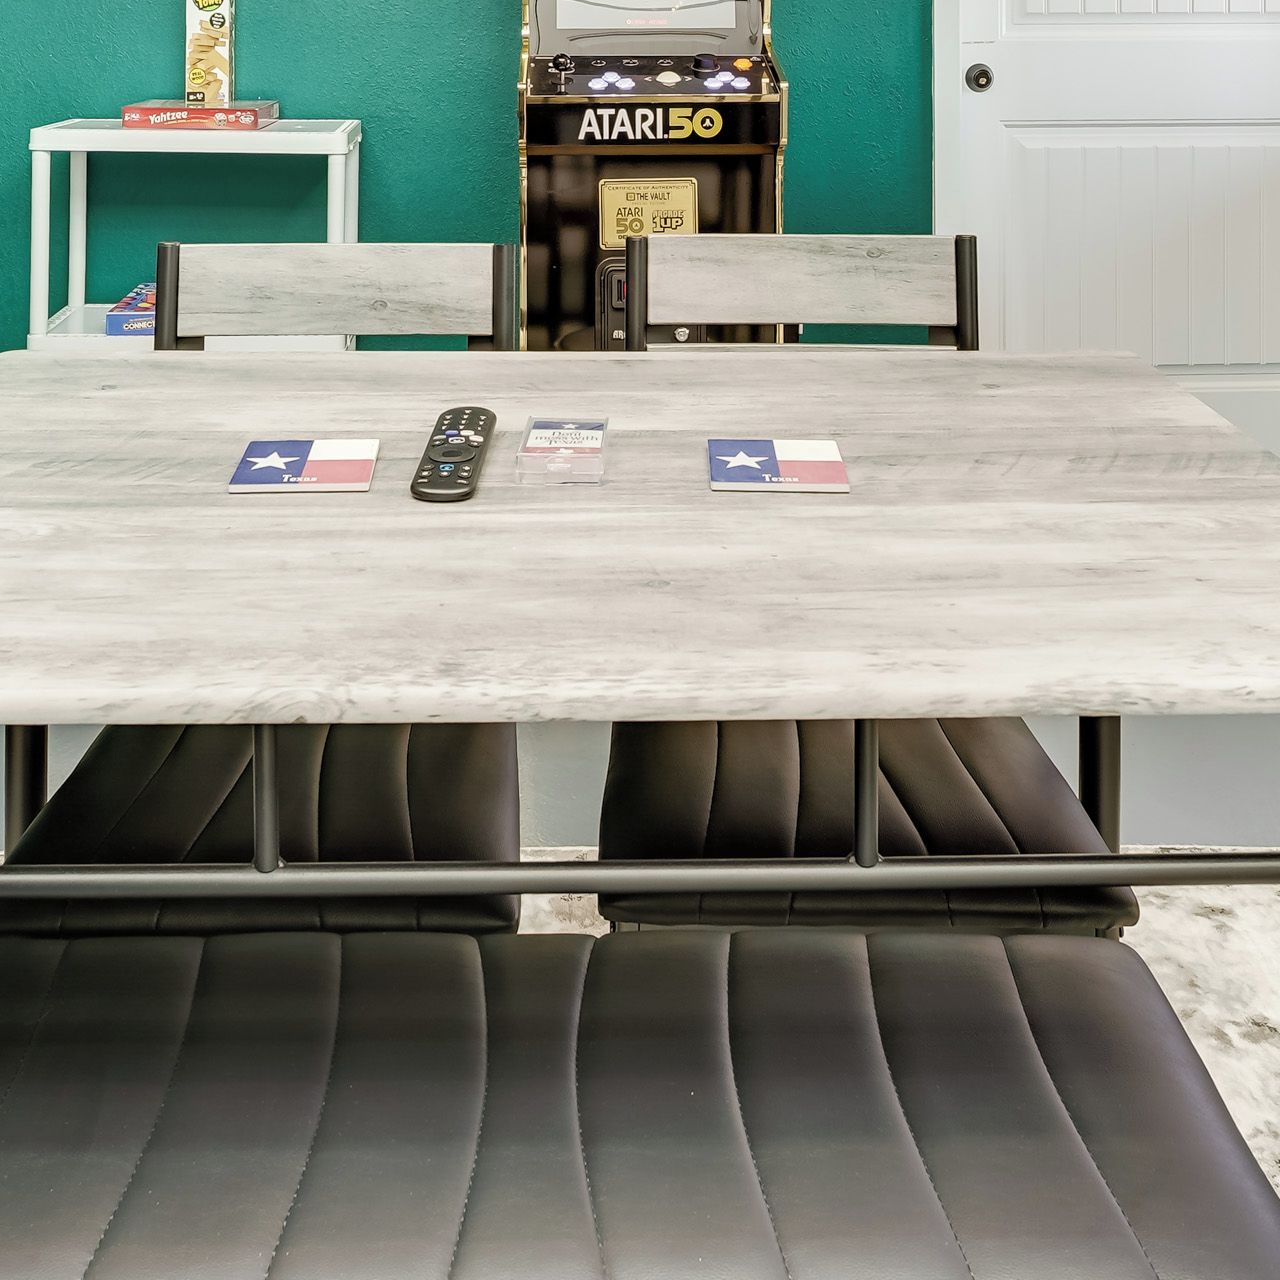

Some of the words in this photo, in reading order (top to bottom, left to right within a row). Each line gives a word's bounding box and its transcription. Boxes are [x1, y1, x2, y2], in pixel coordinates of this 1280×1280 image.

[149, 111, 188, 125] Yahtzee
[578, 108, 663, 140] ATARI
[669, 107, 724, 139] 50
[636, 192, 648, 200] THE
[649, 192, 671, 200] VAULT
[616, 206, 644, 217] ATARI
[616, 218, 644, 234] 50
